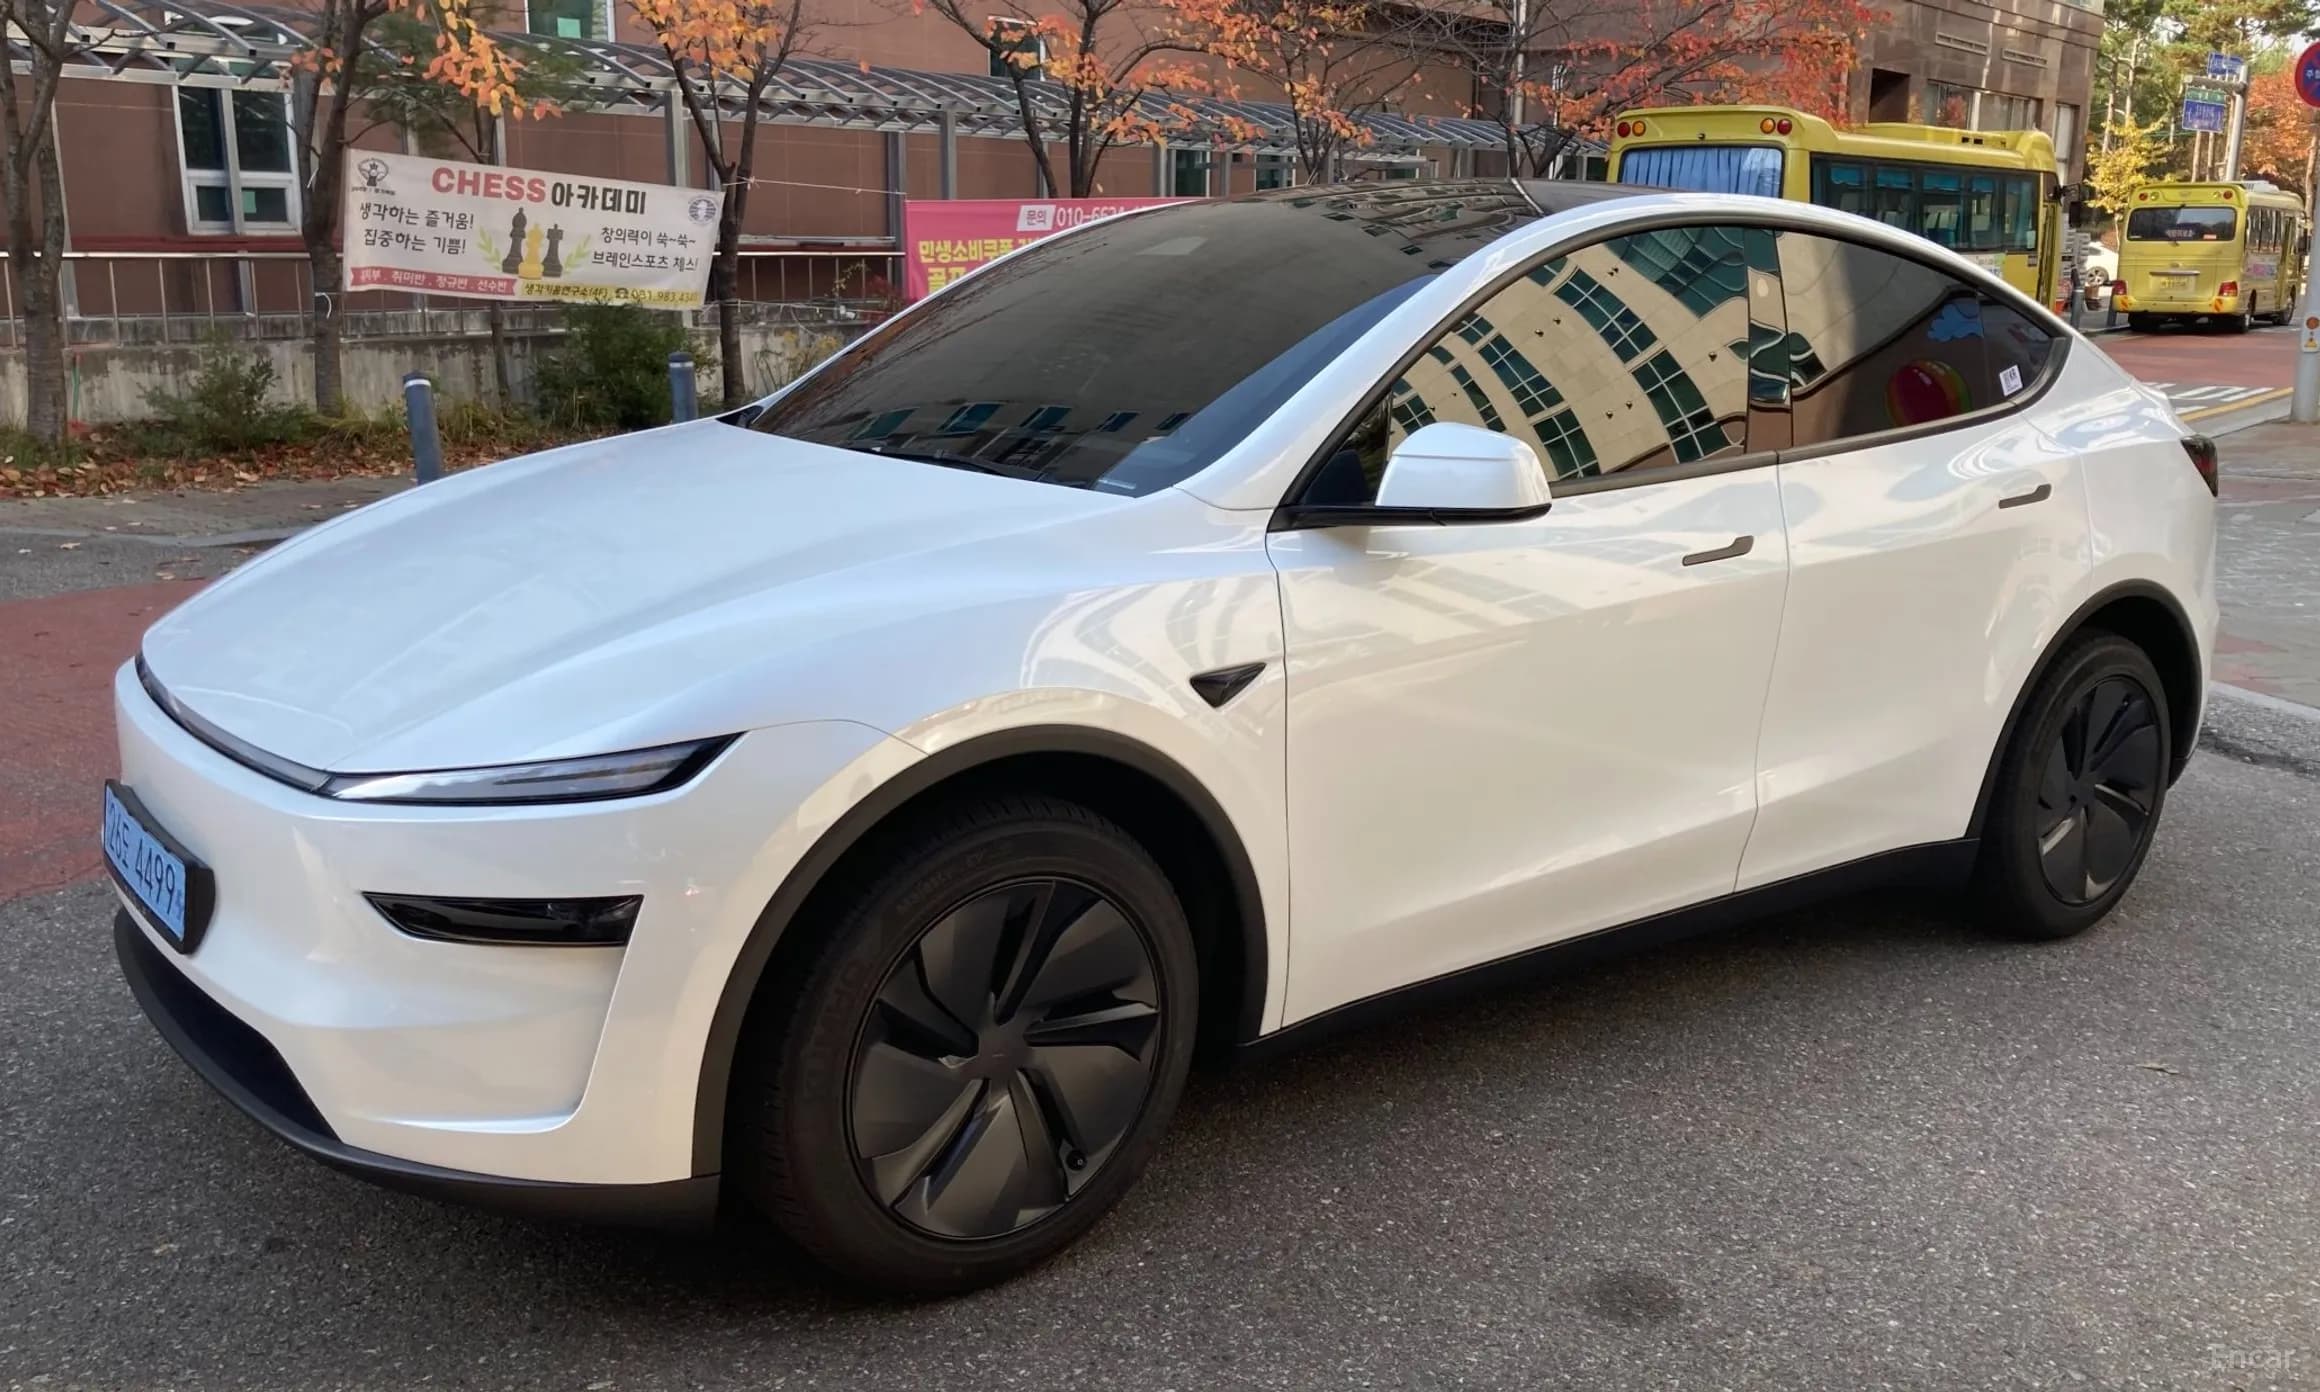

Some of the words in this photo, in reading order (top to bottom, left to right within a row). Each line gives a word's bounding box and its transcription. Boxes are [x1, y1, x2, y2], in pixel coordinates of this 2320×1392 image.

[432, 167, 546, 203] CHESS
[551, 182, 646, 215] 아카데미
[360, 202, 420, 226] 생각하는
[424, 209, 474, 230] 즐거움!
[1026, 210, 1047, 226] 문의
[364, 229, 426, 252] 집중하는
[433, 236, 466, 255] 기쁨!
[601, 227, 652, 247] 창의력이
[592, 251, 668, 269] 브레인스포츠
[135, 839, 175, 914] 4499
